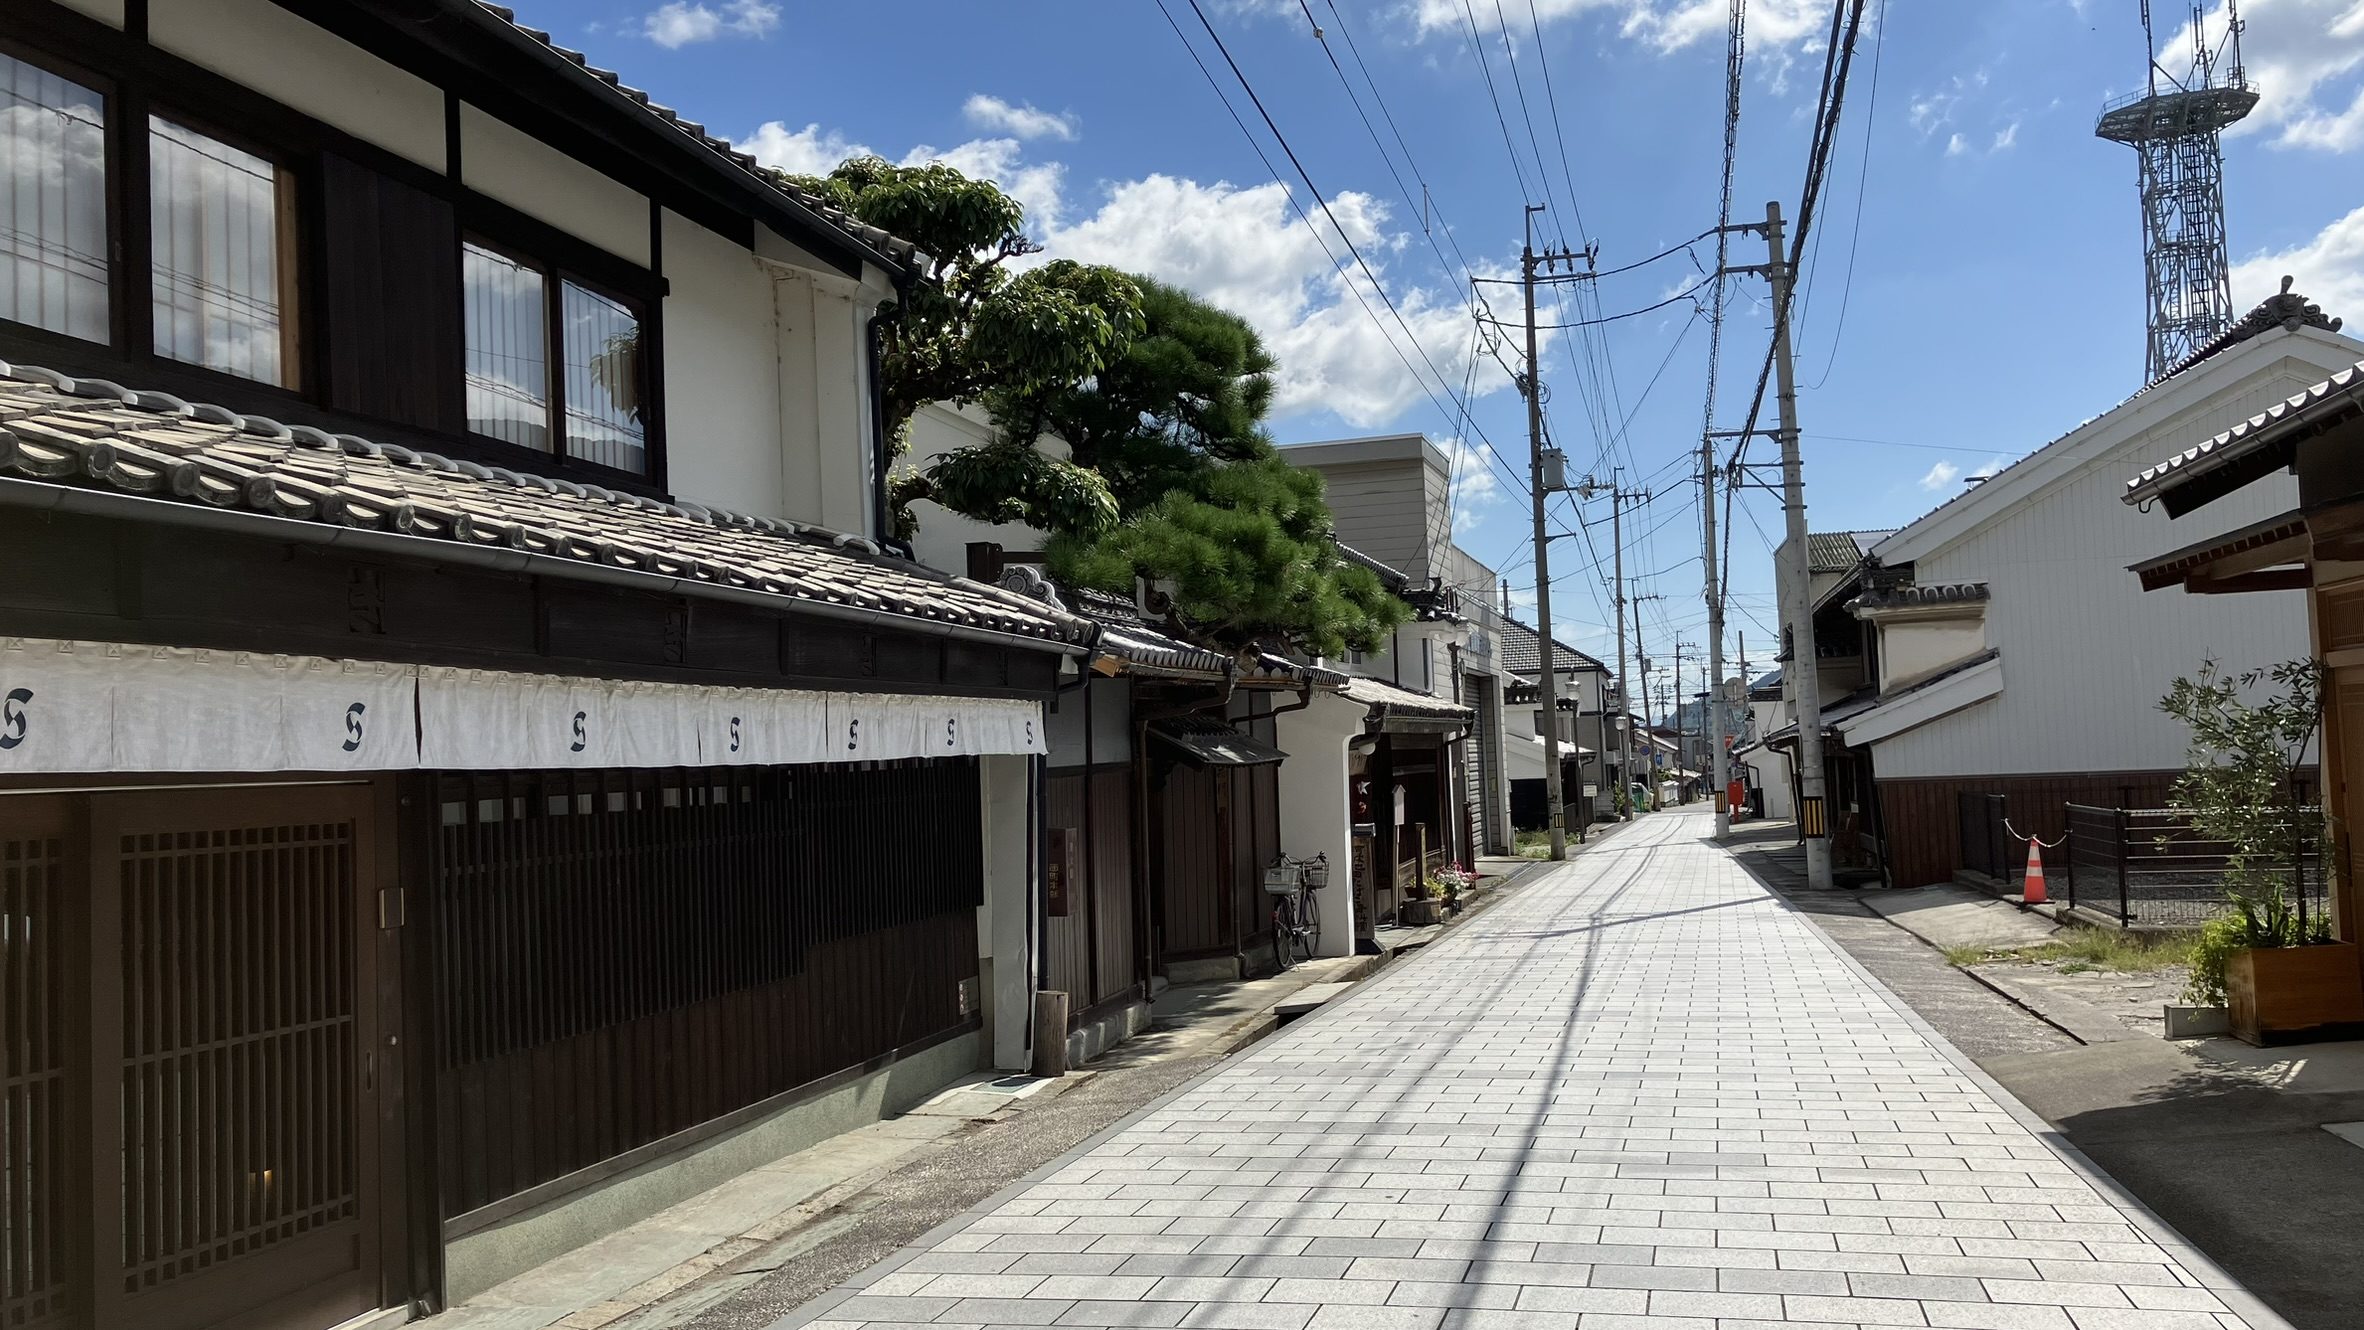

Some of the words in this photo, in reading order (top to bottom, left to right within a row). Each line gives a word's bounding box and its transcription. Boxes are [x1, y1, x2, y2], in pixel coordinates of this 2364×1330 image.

[341, 702, 366, 752] S
[570, 710, 587, 753] S
[730, 716, 741, 753] S
